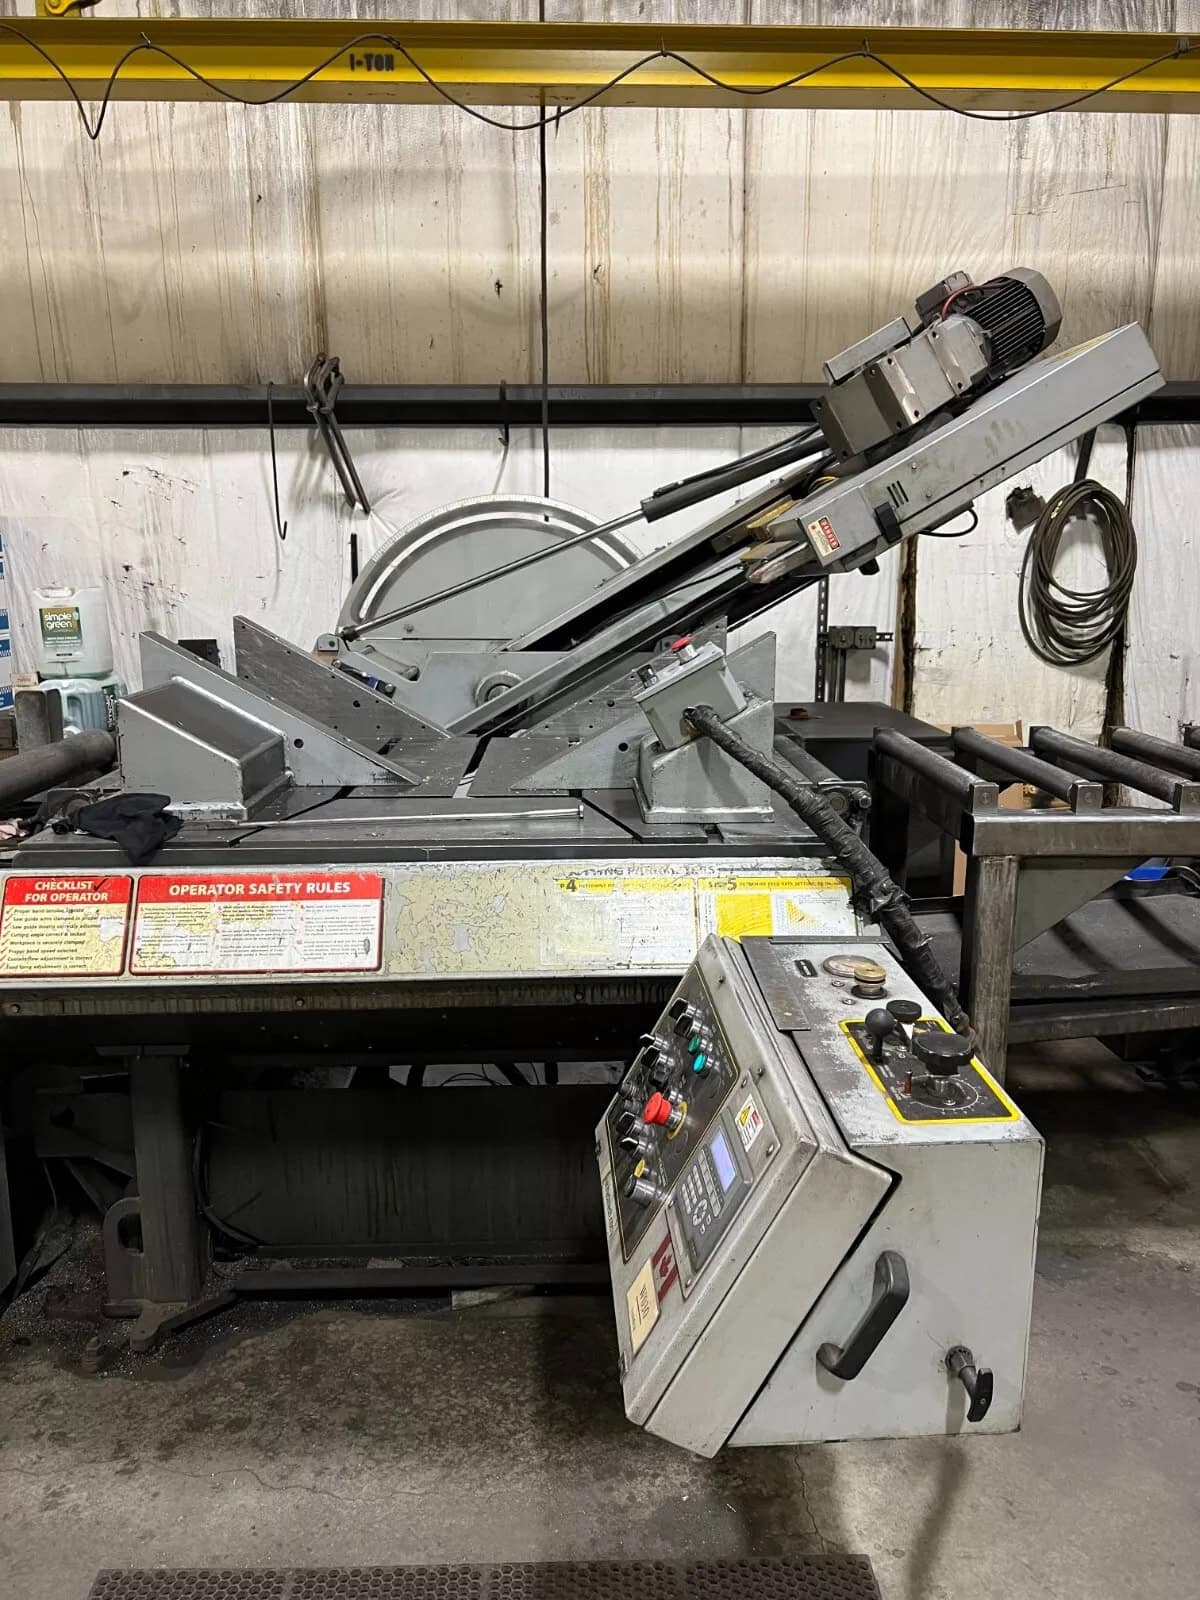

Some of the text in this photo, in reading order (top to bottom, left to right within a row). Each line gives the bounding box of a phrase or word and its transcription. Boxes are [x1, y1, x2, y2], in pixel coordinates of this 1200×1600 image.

[44, 611, 72, 621] simple
[46, 621, 73, 631] green
[35, 880, 94, 891] CHECKLIST
[169, 882, 351, 896] OPERATOR SAFETY RULES
[727, 877, 738, 891] 5
[25, 892, 108, 902] FOR OPERATOR
